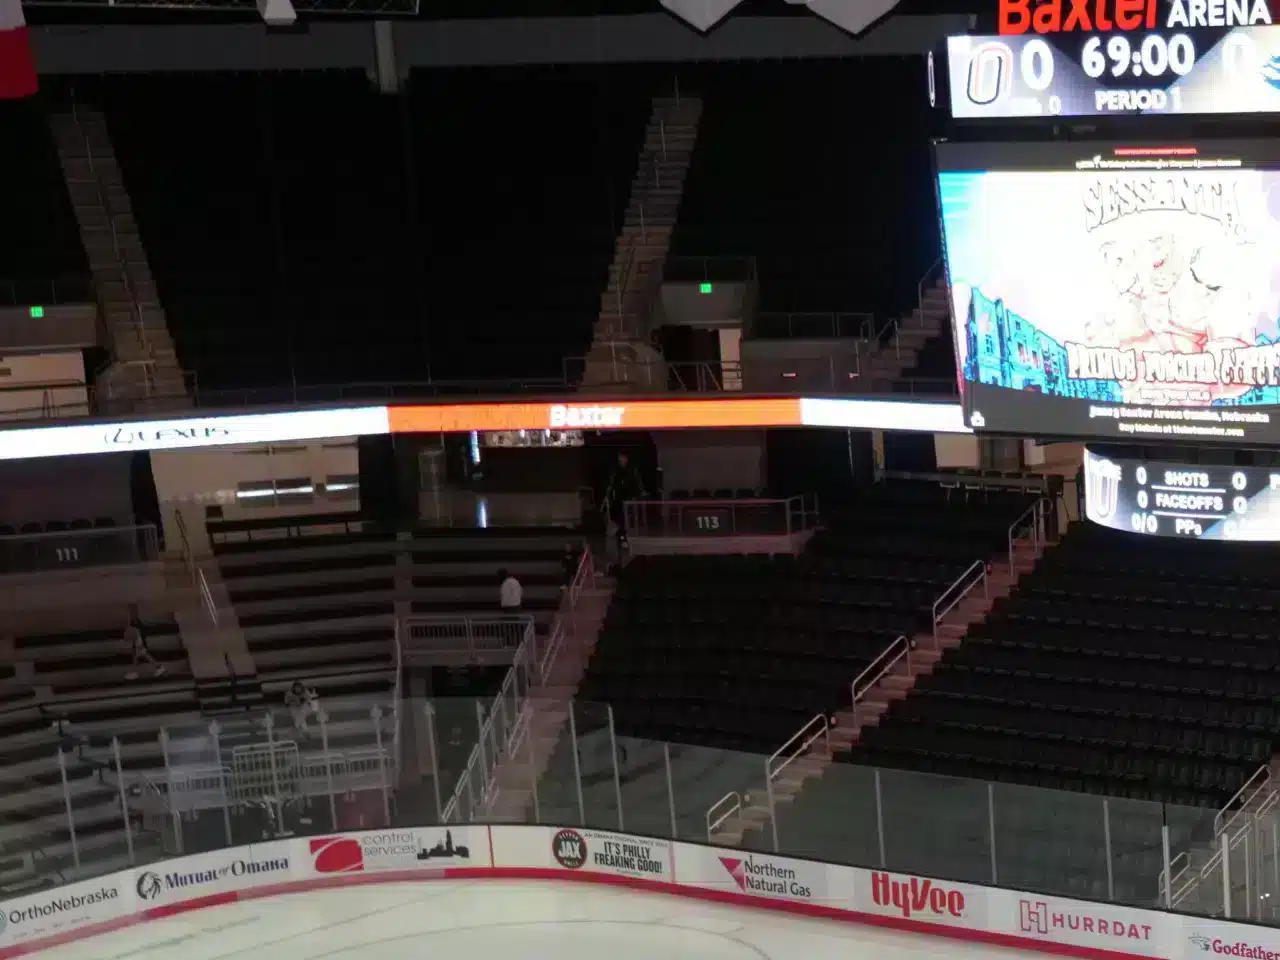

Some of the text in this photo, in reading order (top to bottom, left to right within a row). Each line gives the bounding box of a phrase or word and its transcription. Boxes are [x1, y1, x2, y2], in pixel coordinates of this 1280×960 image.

[1166, 0, 1272, 27] ARENA
[1081, 33, 1196, 77] 69:00
[1094, 89, 1170, 111] PERIOD
[1164, 470, 1209, 487] SHOTS
[1155, 493, 1223, 511] FACEOFFS
[697, 516, 720, 529] 113
[56, 548, 78, 561] 111
[362, 832, 414, 846] control
[363, 844, 417, 857] services
[558, 840, 582, 859] JAX
[604, 841, 651, 860] IT'S PHILLY
[594, 852, 635, 870] FREAKING
[637, 859, 663, 874] GOOD!
[744, 856, 796, 880] Northern
[745, 876, 811, 898] Natural Gas
[9, 885, 119, 925] OrthoNebraska
[1052, 913, 1152, 941] HURRDAT
